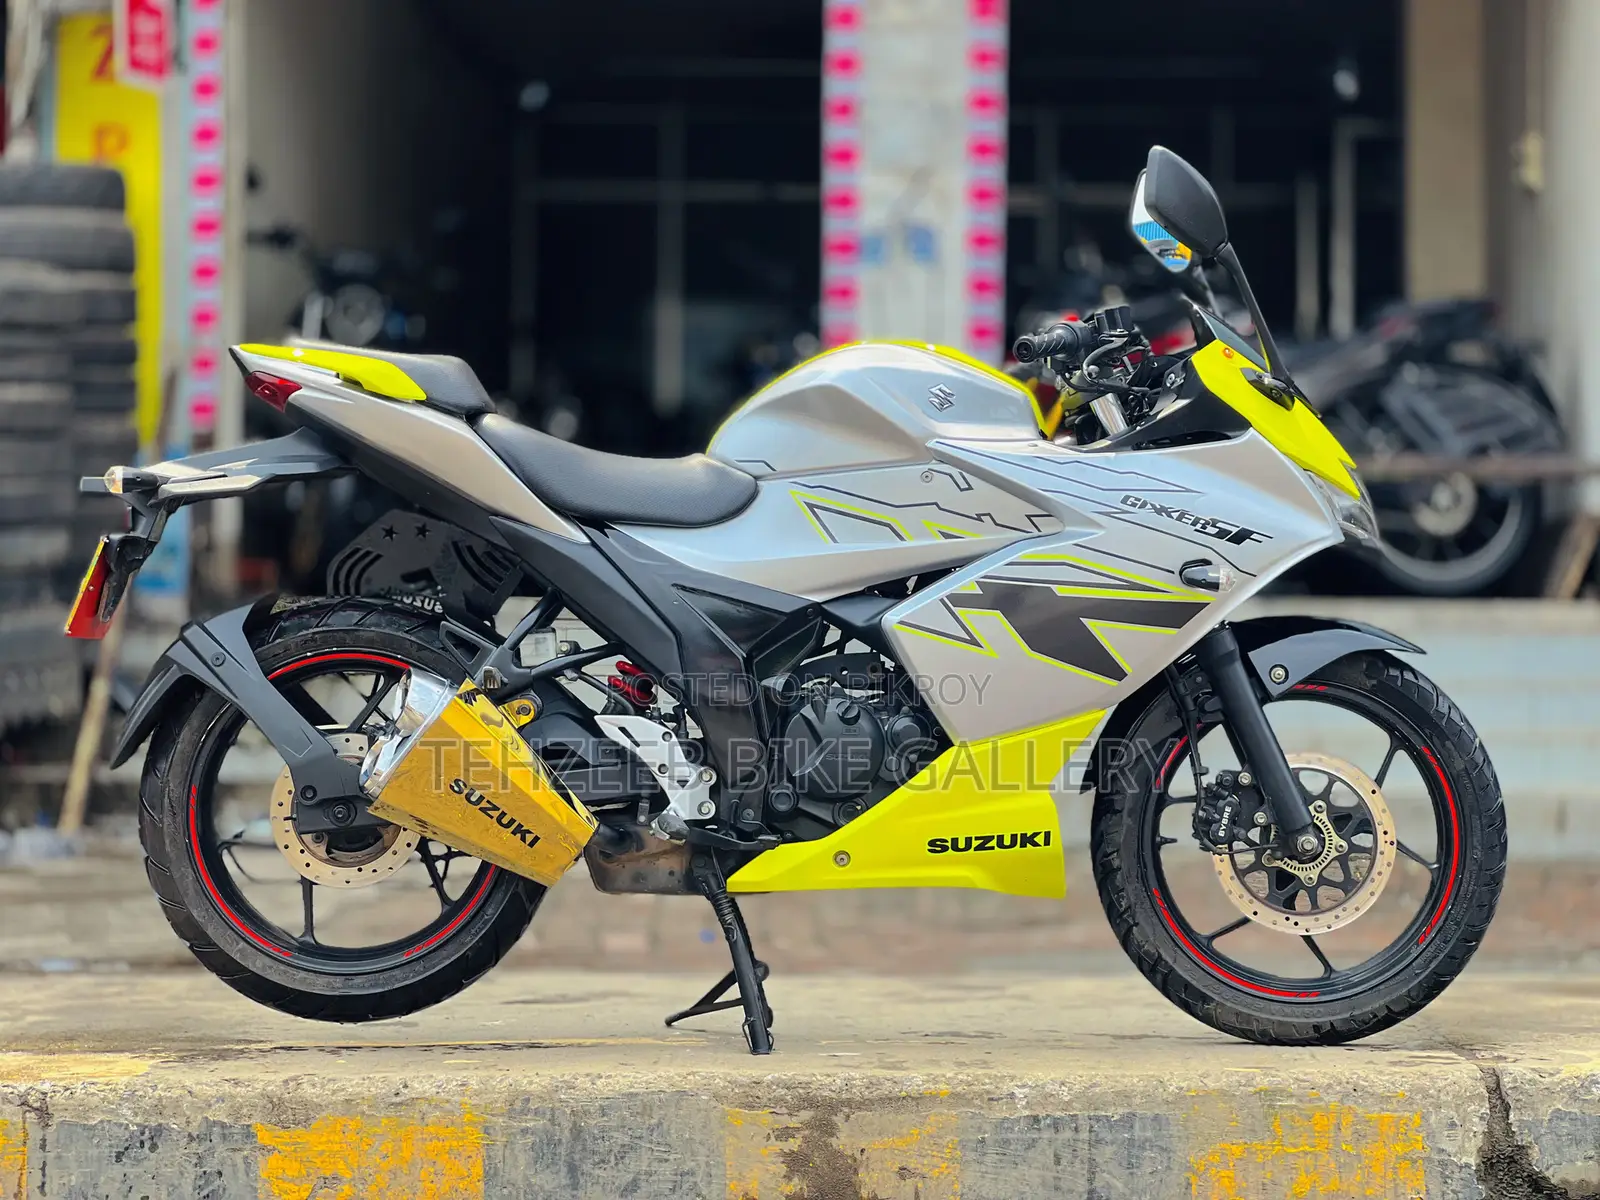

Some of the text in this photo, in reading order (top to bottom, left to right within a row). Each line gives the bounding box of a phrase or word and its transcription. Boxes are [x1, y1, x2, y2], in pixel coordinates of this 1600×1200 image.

[1120, 494, 1274, 546] GIXXER SF
[449, 778, 541, 849] SUZUKI
[1218, 805, 1232, 837] BYBRE
[926, 830, 1051, 854] SUZUKI
